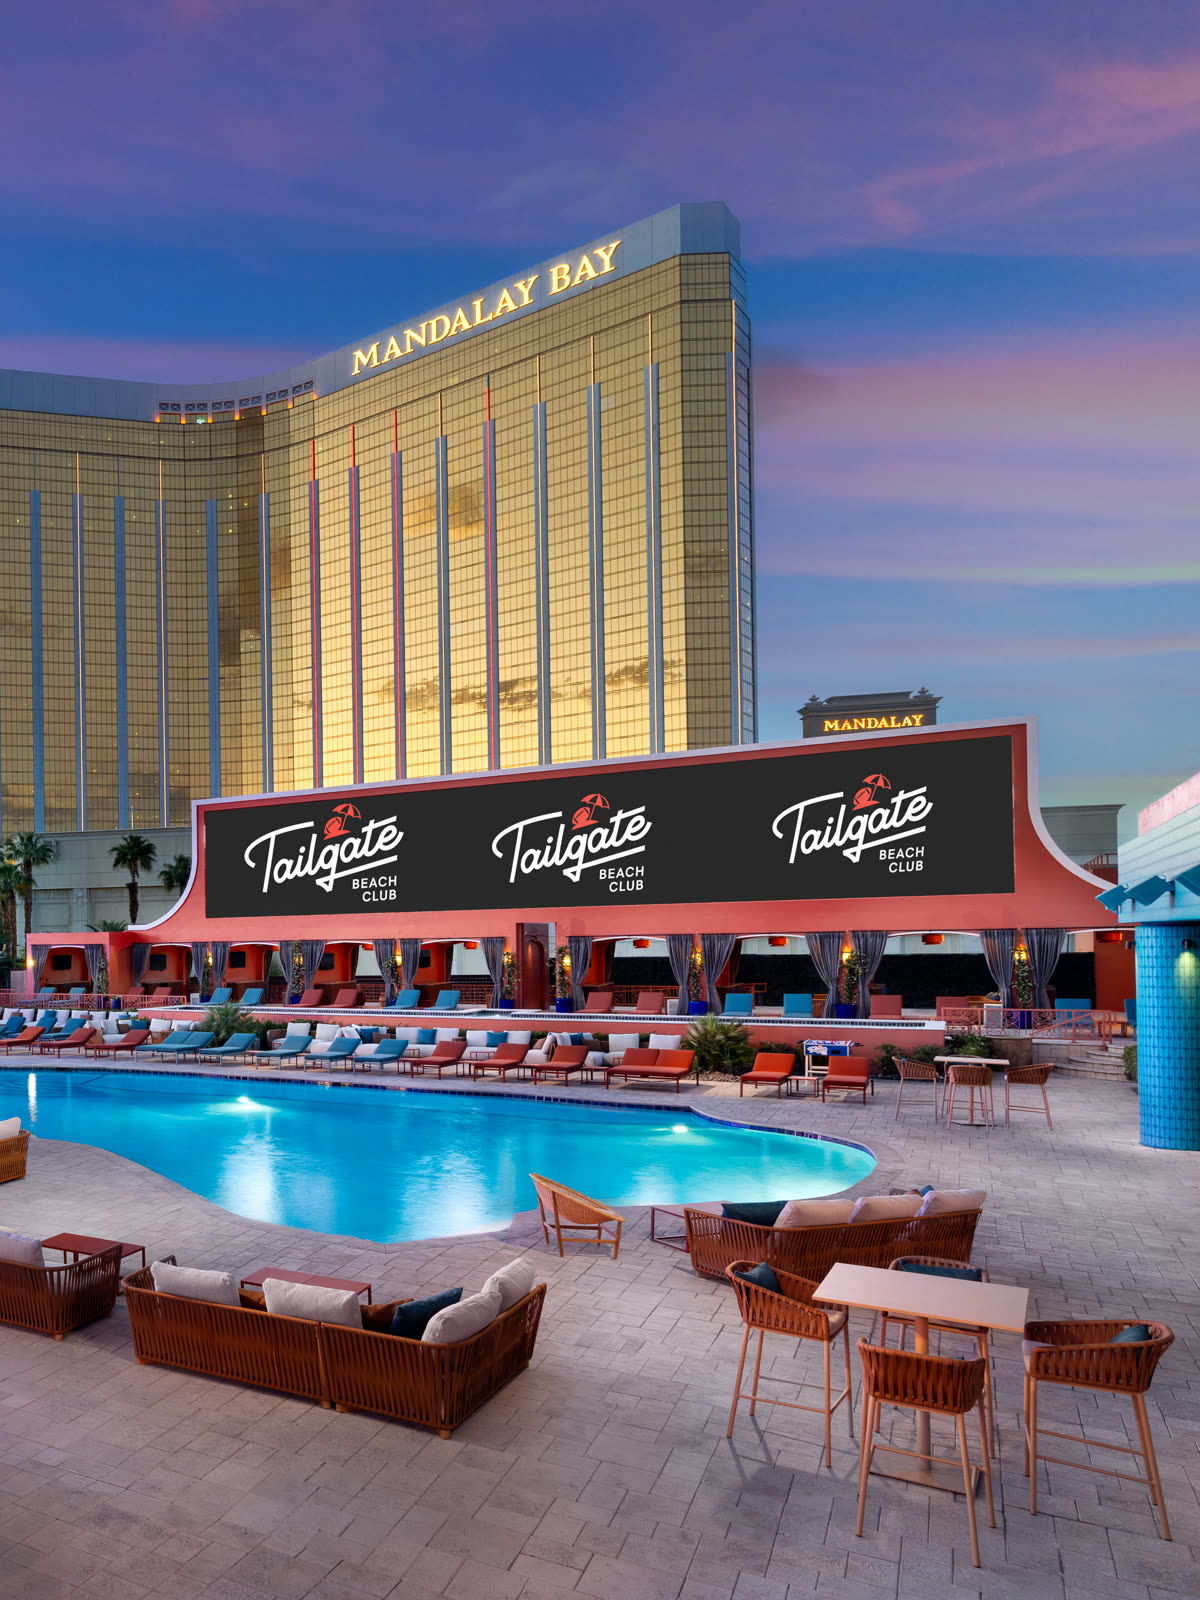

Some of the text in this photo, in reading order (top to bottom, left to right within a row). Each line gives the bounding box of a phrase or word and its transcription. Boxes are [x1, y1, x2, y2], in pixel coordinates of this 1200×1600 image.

[351, 239, 622, 376] MANDALAY BAY
[822, 713, 925, 732] MANDALAY
[771, 785, 935, 864] Tailgate
[491, 805, 653, 883] Tailgate
[243, 815, 405, 893] Tailgate
[879, 846, 925, 861] BEACH
[599, 865, 645, 880] BEACH
[888, 860, 925, 874] CLUB
[352, 875, 398, 890] BEACH
[608, 879, 645, 893] CLUB
[362, 889, 398, 903] CLUB
